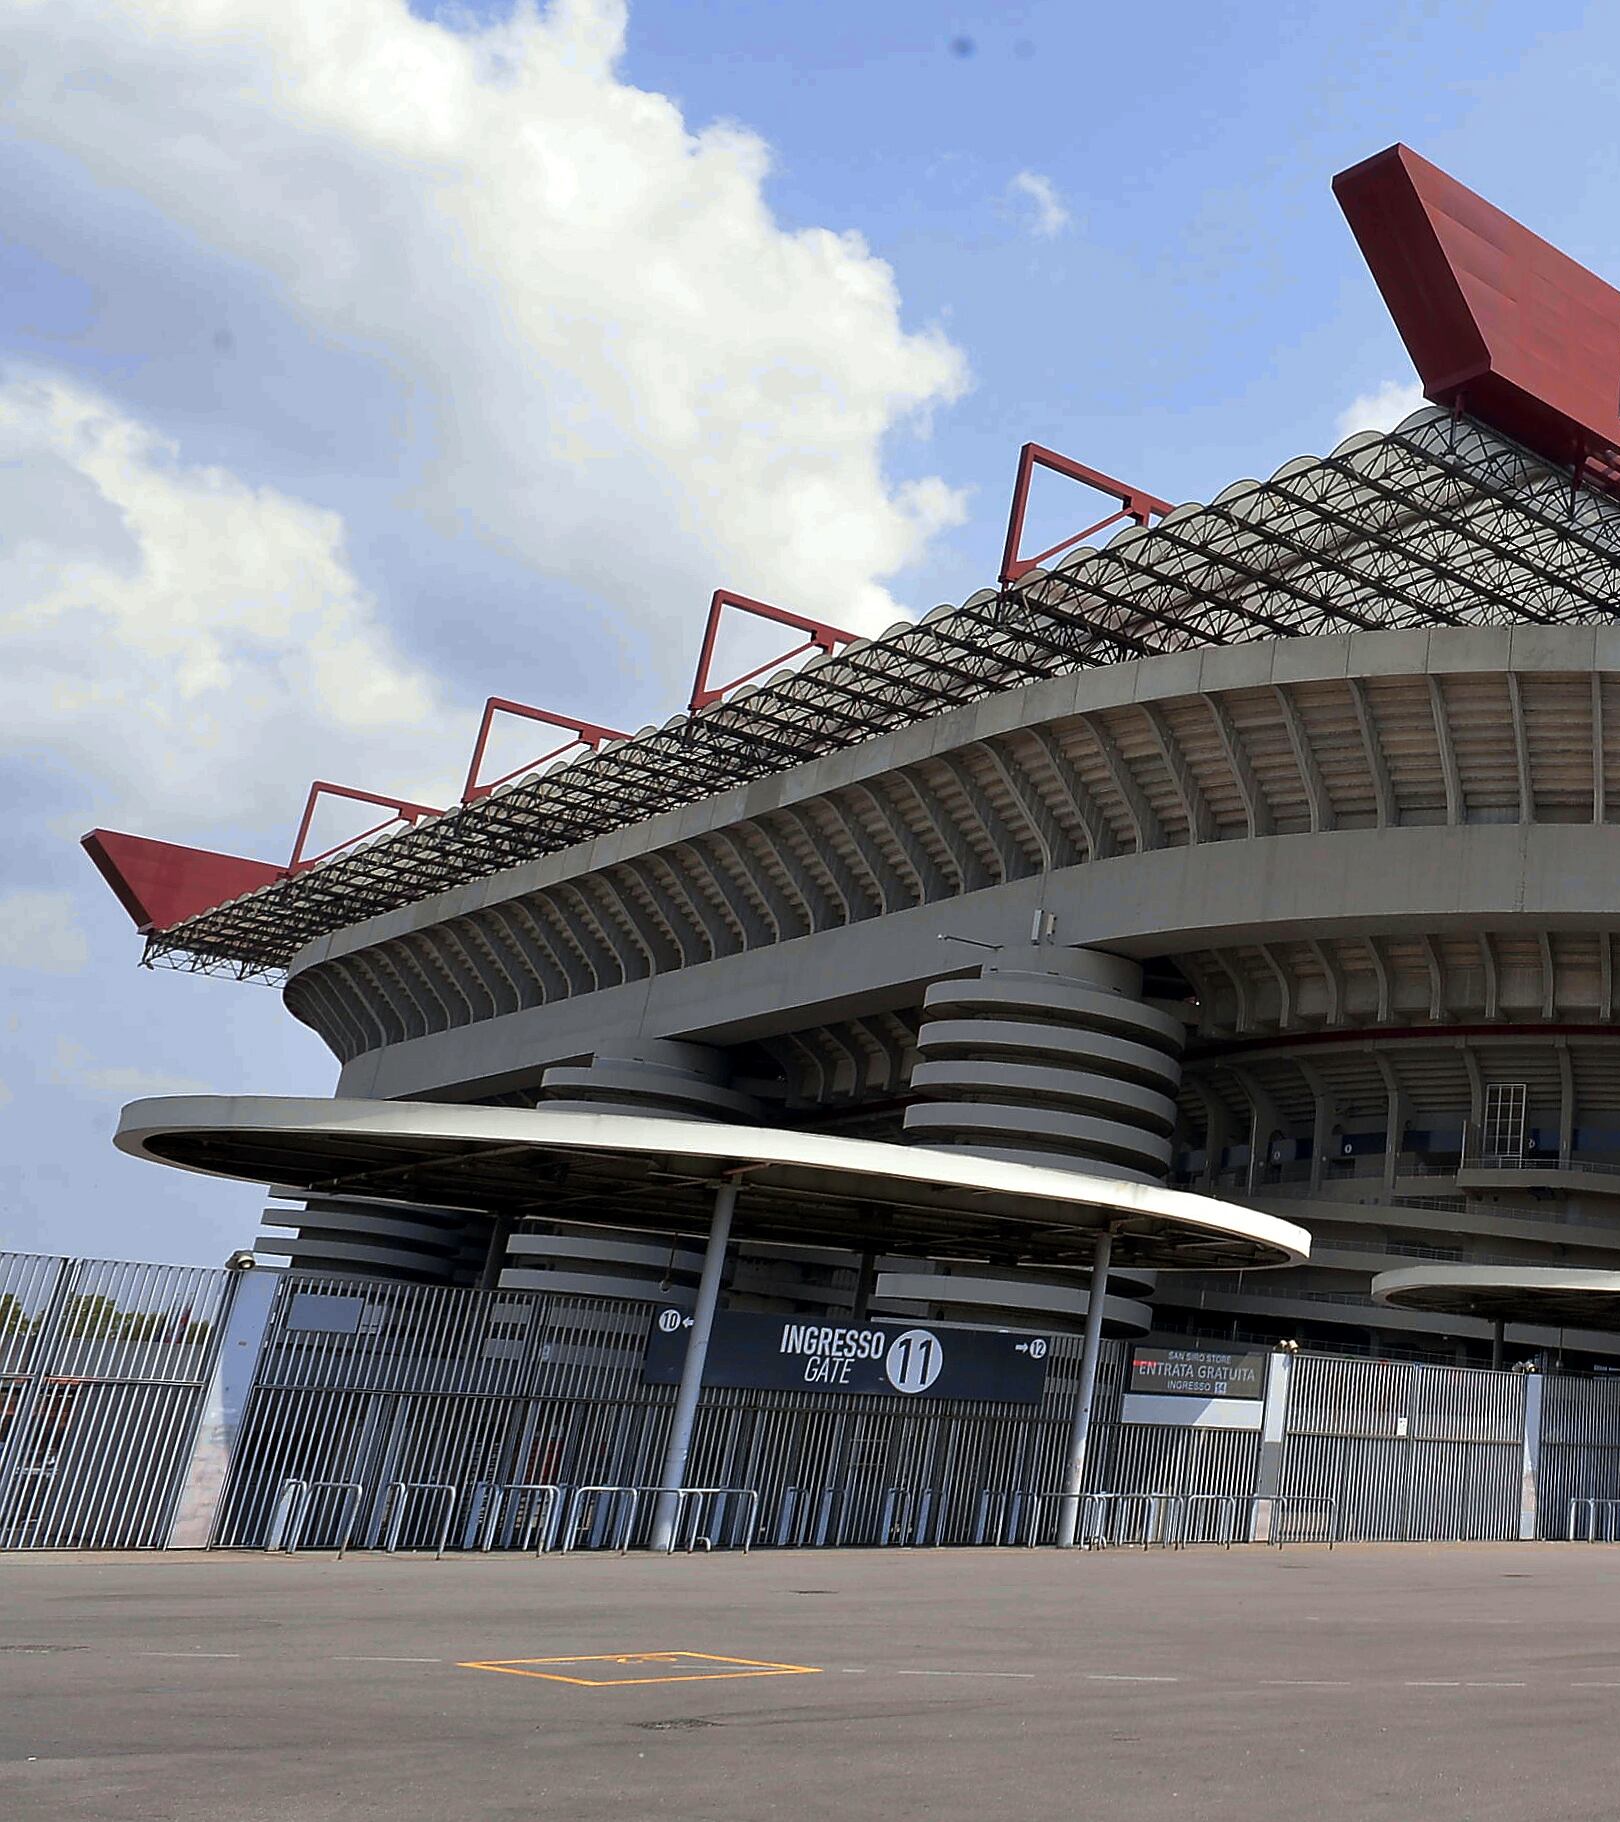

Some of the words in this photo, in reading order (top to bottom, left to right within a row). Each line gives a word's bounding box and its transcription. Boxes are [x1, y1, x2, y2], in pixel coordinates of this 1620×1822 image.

[780, 1324, 886, 1360] INGRESSO
[804, 1355, 856, 1384] GATE
[898, 1337, 933, 1385] 11
[1168, 1351, 1184, 1361] SAN
[1207, 1354, 1232, 1364] STORE
[1139, 1361, 1194, 1378] ENTRATA
[1197, 1365, 1255, 1382] GRATUITA
[1167, 1380, 1211, 1392] INGRESSO
